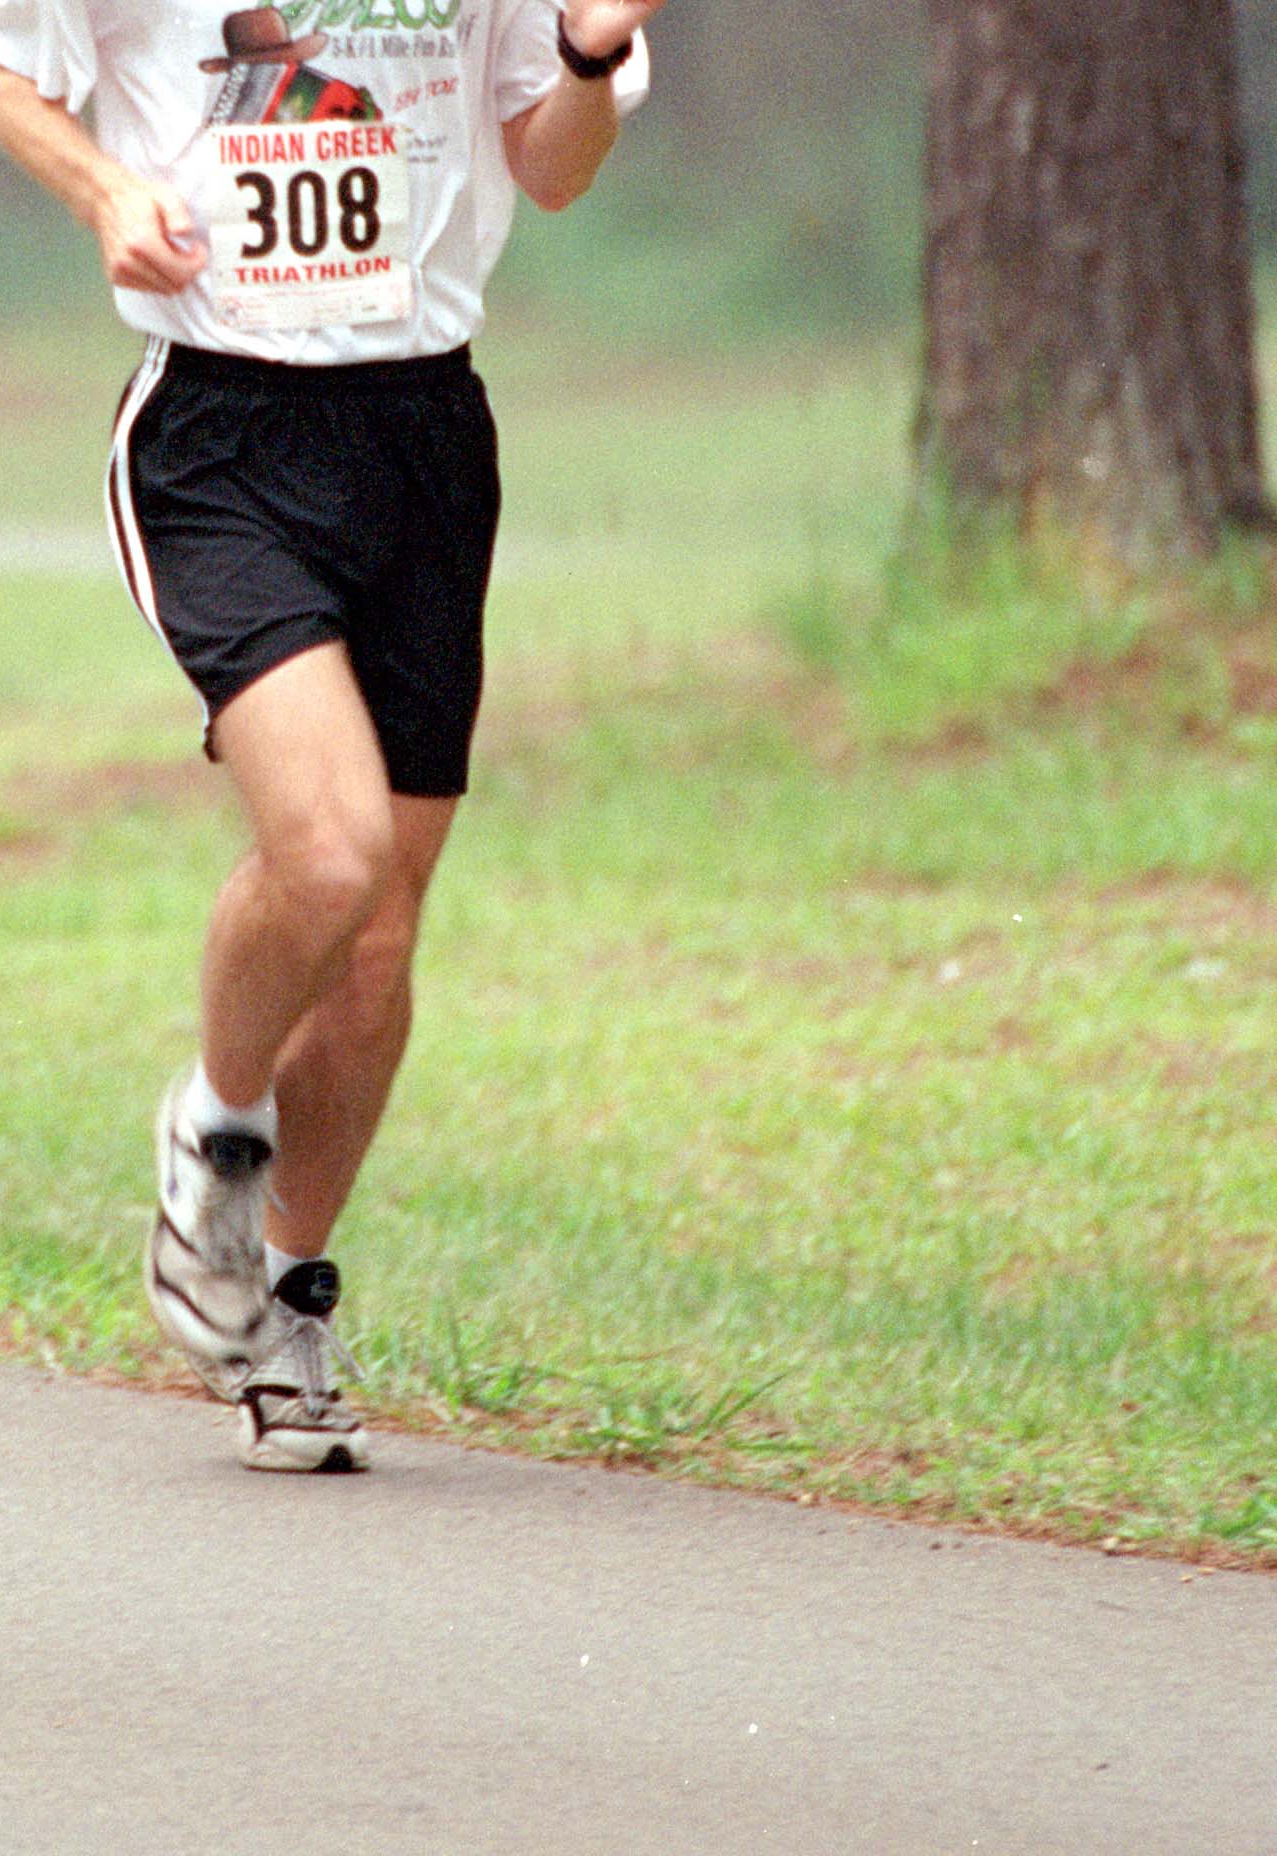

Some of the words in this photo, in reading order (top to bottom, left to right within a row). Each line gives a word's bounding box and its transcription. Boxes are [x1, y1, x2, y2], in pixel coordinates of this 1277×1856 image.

[219, 132, 306, 165] INDIAN
[315, 126, 398, 162] CREEK
[234, 165, 382, 260] 308
[233, 256, 392, 285] TRIATHLON
